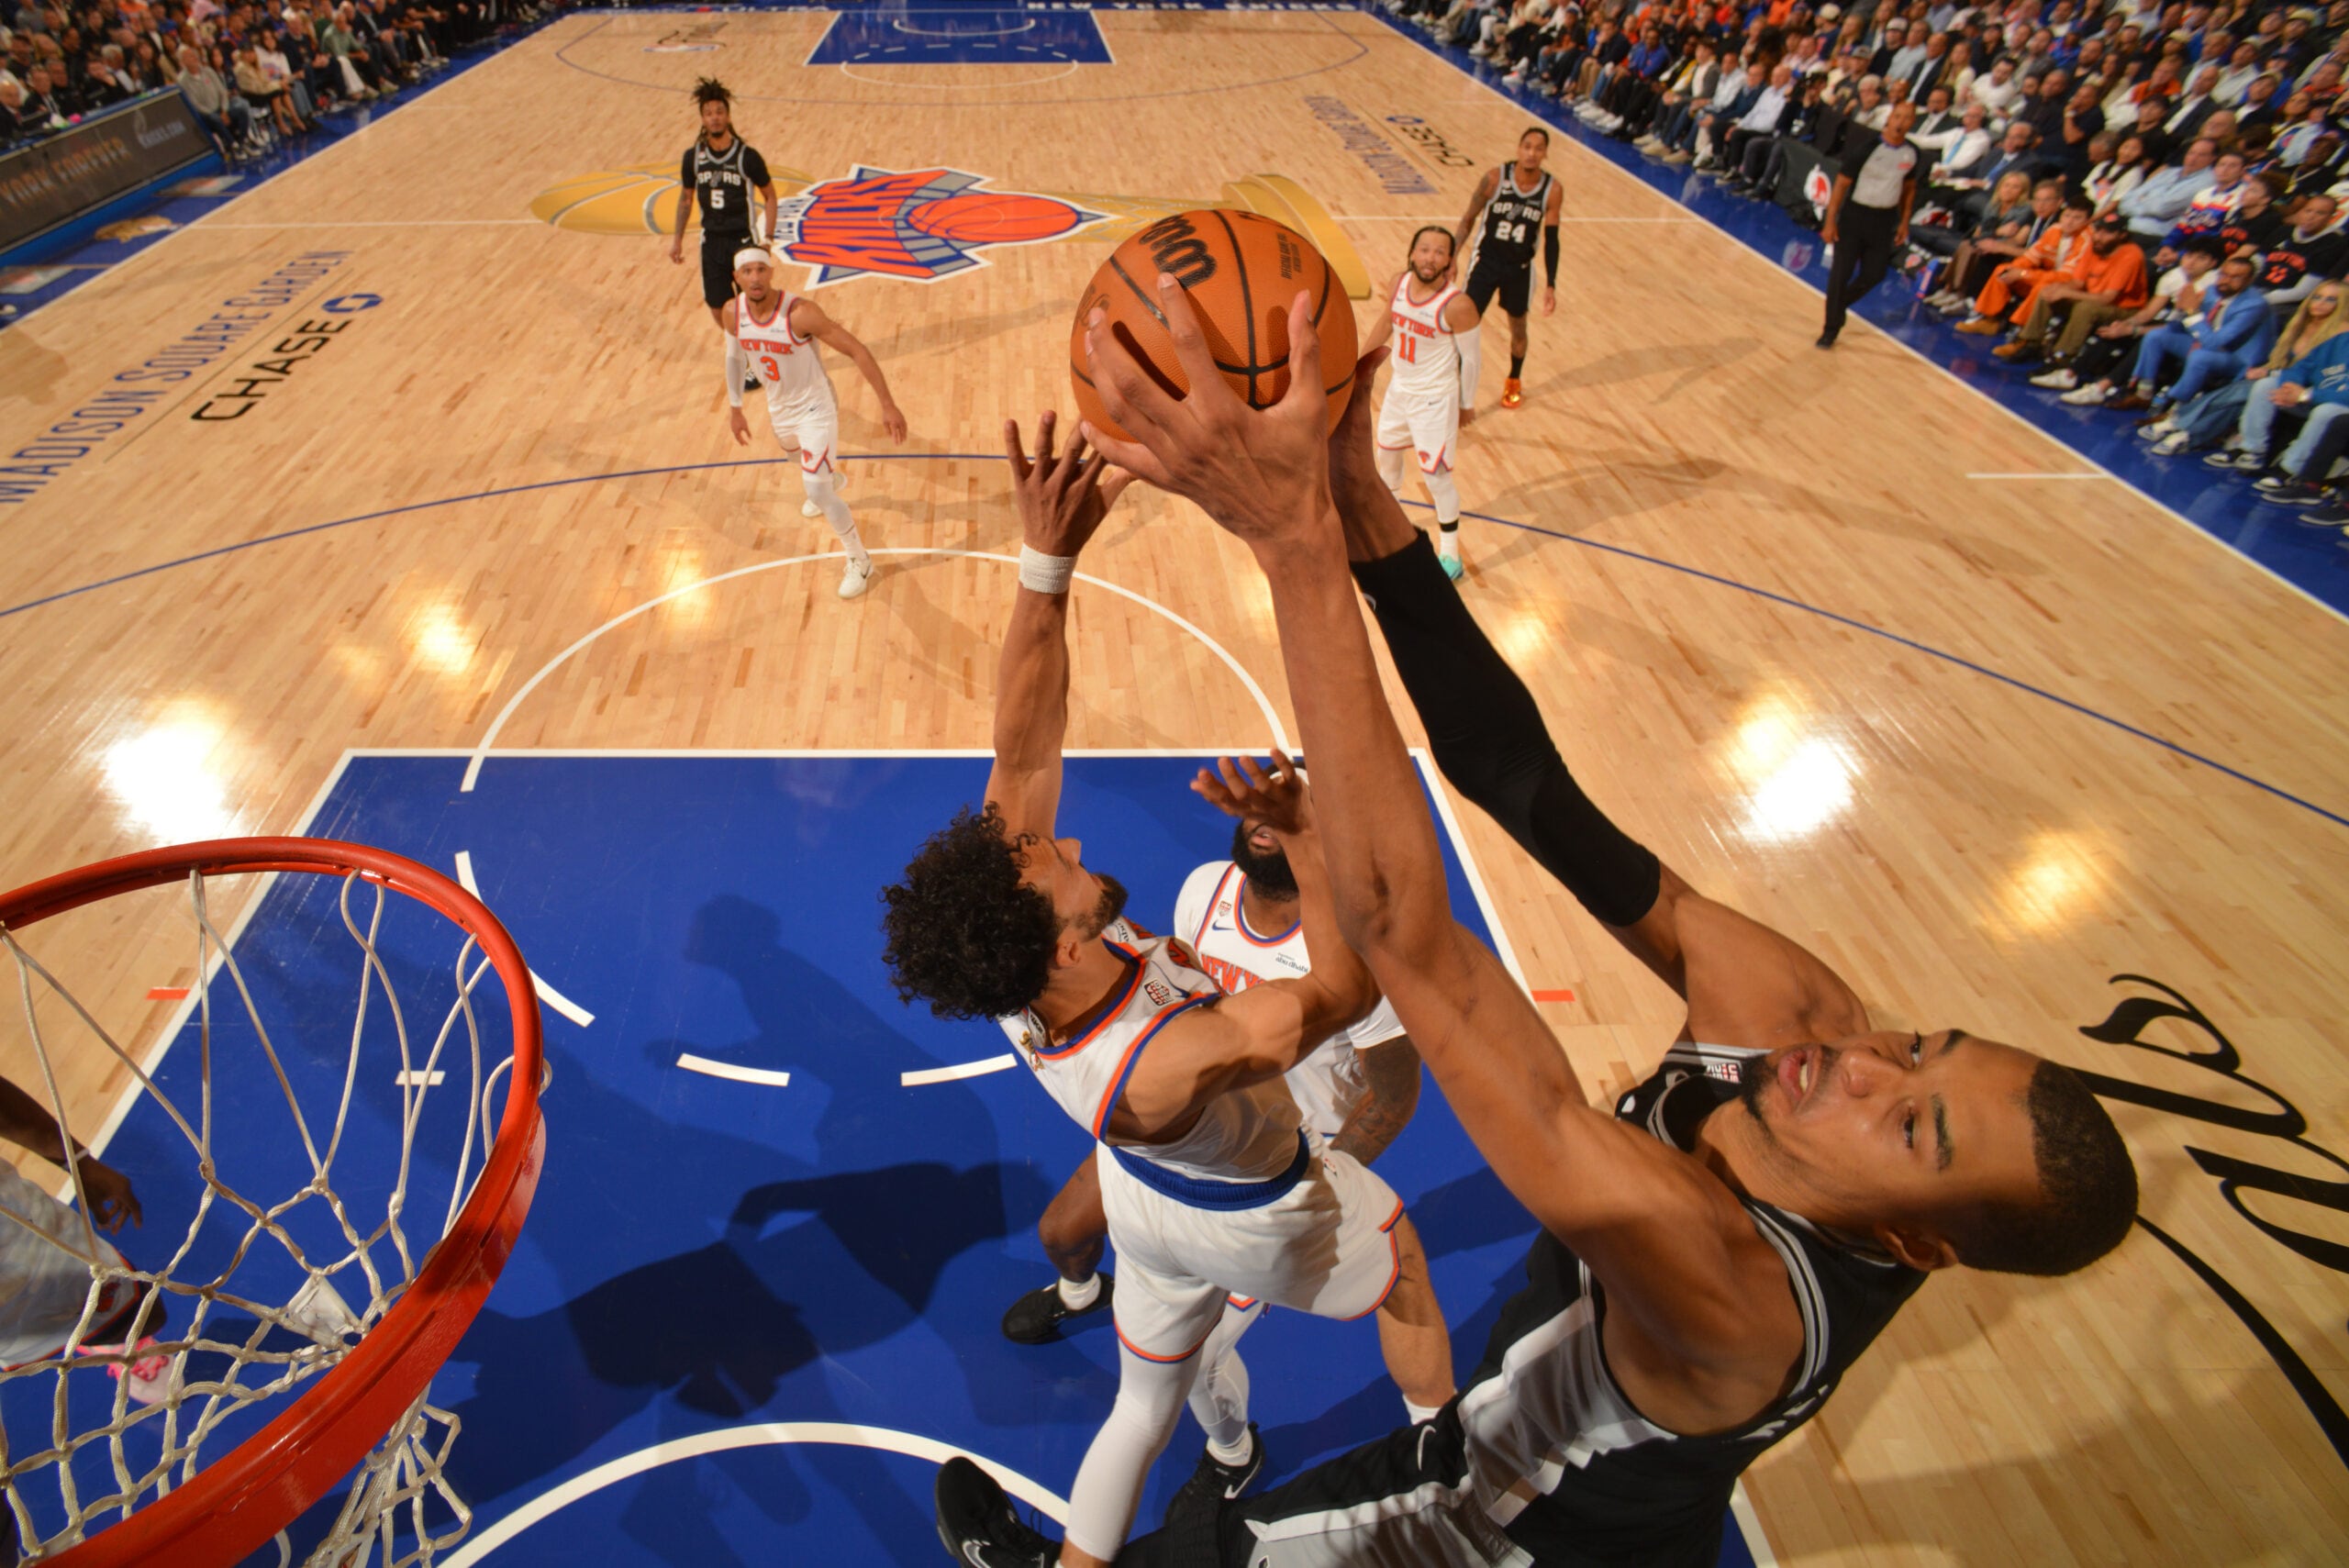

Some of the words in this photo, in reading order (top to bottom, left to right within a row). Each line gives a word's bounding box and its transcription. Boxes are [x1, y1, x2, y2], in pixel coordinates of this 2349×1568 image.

[710, 189, 725, 209] 5
[784, 169, 951, 279] KNICKS
[1495, 220, 1526, 244] 24
[1398, 332, 1416, 363] 11
[0, 390, 169, 503] MADISON
[114, 311, 273, 382] SQUARE
[223, 250, 354, 306] GARDEN
[191, 318, 352, 421] CHASE
[760, 356, 780, 382] 3
